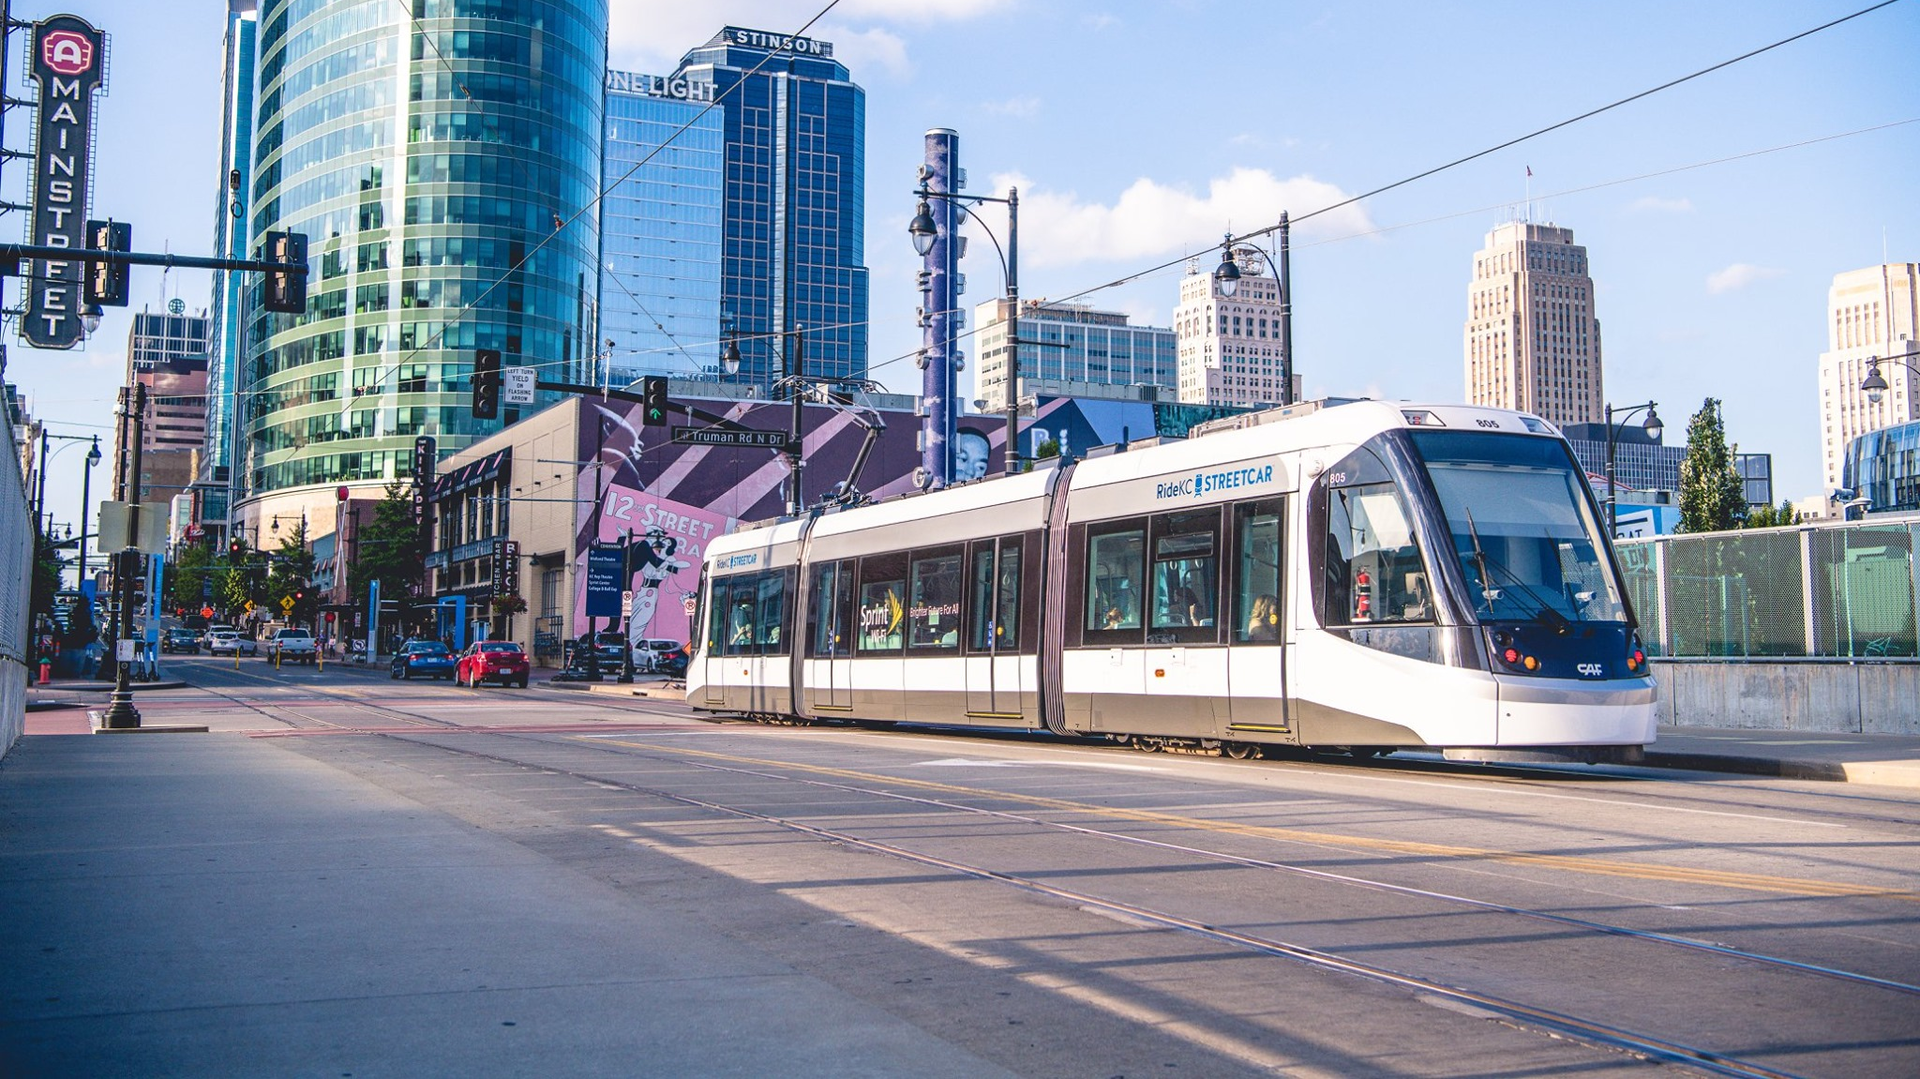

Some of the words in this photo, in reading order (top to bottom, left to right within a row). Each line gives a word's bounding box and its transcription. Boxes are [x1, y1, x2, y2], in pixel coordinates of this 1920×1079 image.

[737, 30, 821, 54] STINSON
[649, 75, 718, 101] LIGHT
[1476, 419, 1500, 429] 805
[692, 431, 734, 442] Truman
[740, 433, 752, 443] Rd
[757, 434, 765, 443] N
[769, 434, 782, 444] Dr
[1156, 479, 1193, 499] RideKC
[1204, 465, 1273, 492] STREETCAR
[1330, 472, 1346, 484] 805
[640, 503, 714, 540] STREET
[733, 553, 757, 567] STREETCAR
[860, 603, 889, 632] Sprint
[909, 606, 928, 619] Brighter
[928, 605, 943, 616] Future
[943, 604, 952, 615] For
[870, 628, 887, 643] Wi-Fi
